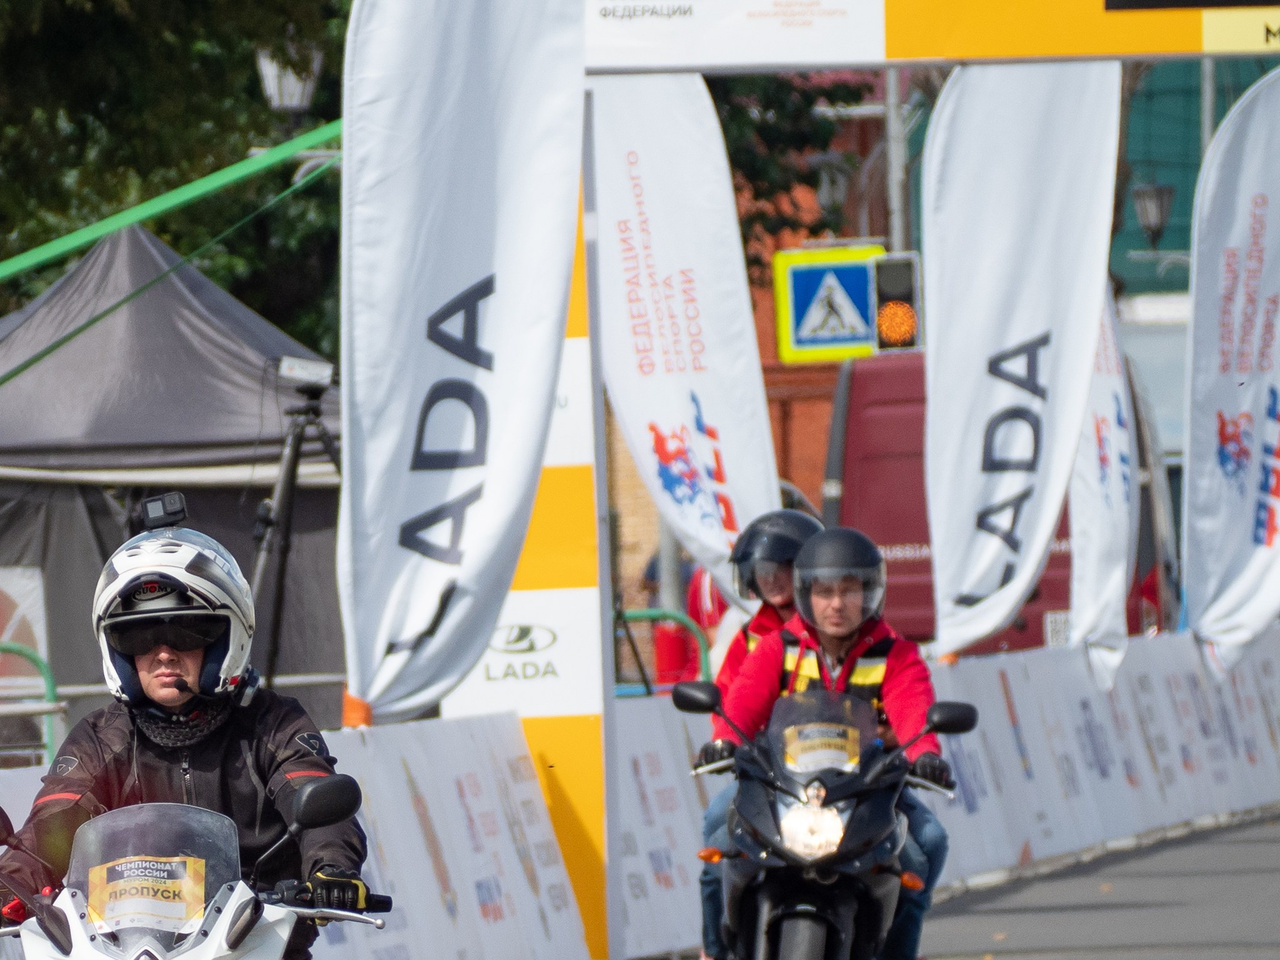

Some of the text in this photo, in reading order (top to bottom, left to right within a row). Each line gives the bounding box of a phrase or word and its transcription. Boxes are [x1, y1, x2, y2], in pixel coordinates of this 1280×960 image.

[599, 4, 694, 19] ФЕДЕРАЦИИ
[617, 218, 656, 376] ФЕДЕРАЦИЯ
[679, 268, 706, 373] РОССИИ
[384, 273, 497, 656] LADA
[483, 661, 559, 682] LADA
[115, 861, 177, 871] ЧЕМПИОНАТ
[123, 869, 168, 878] РОССИИ
[151, 877, 167, 885] 2024
[108, 886, 182, 901] ПРОПУСК
